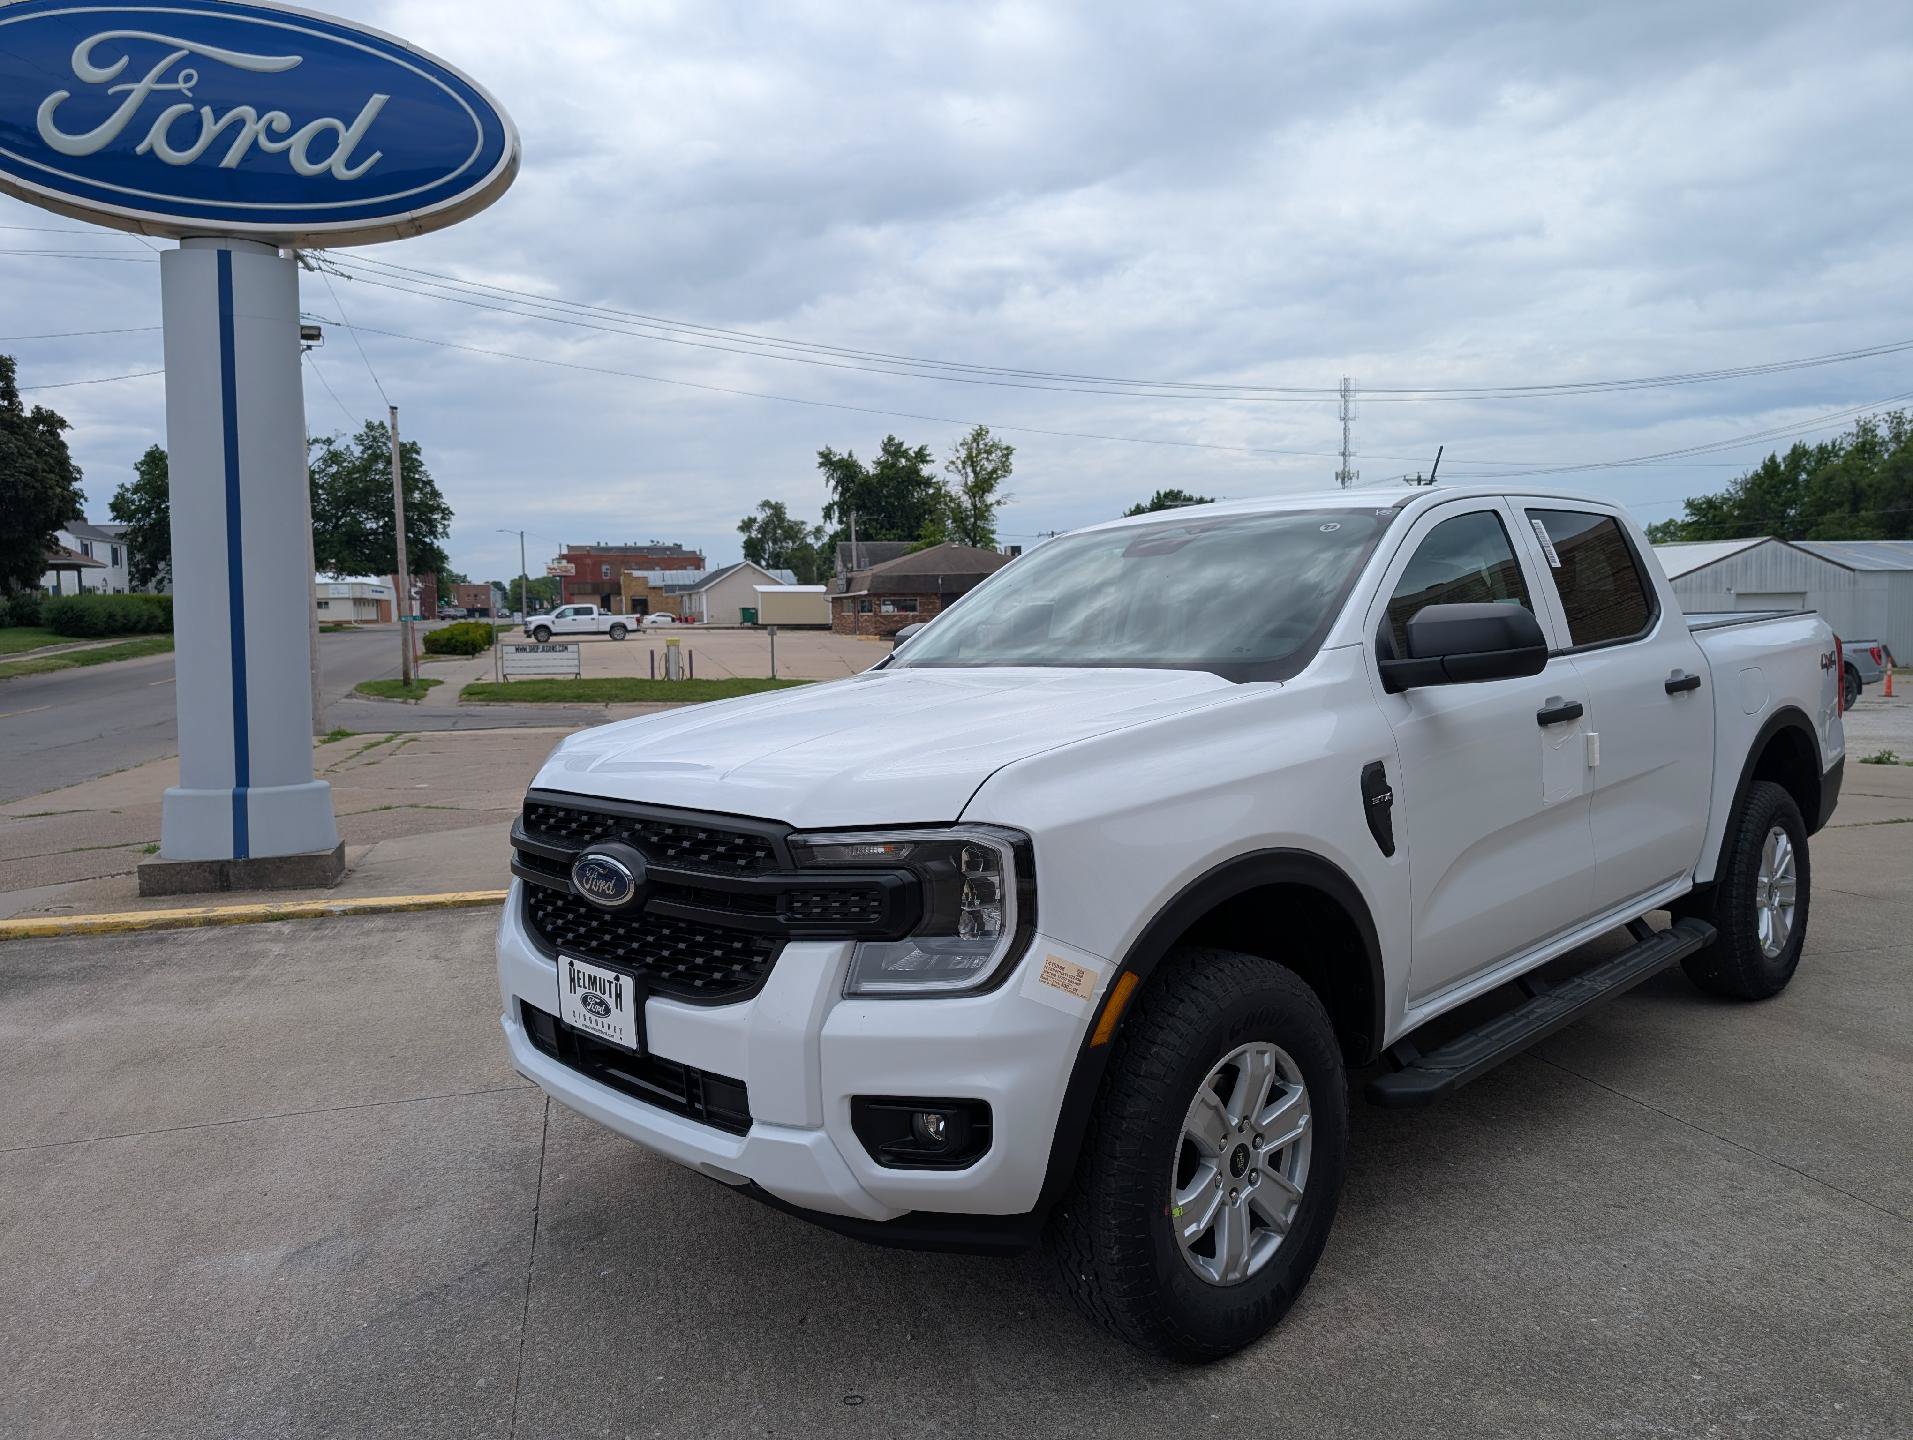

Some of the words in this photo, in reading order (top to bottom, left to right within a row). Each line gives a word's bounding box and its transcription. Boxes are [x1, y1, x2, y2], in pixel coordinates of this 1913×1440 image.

[37, 30, 390, 180] Ford
[583, 864, 616, 895] Ford
[568, 965, 623, 1012] HELMUTH
[586, 995, 606, 1014] Ford
